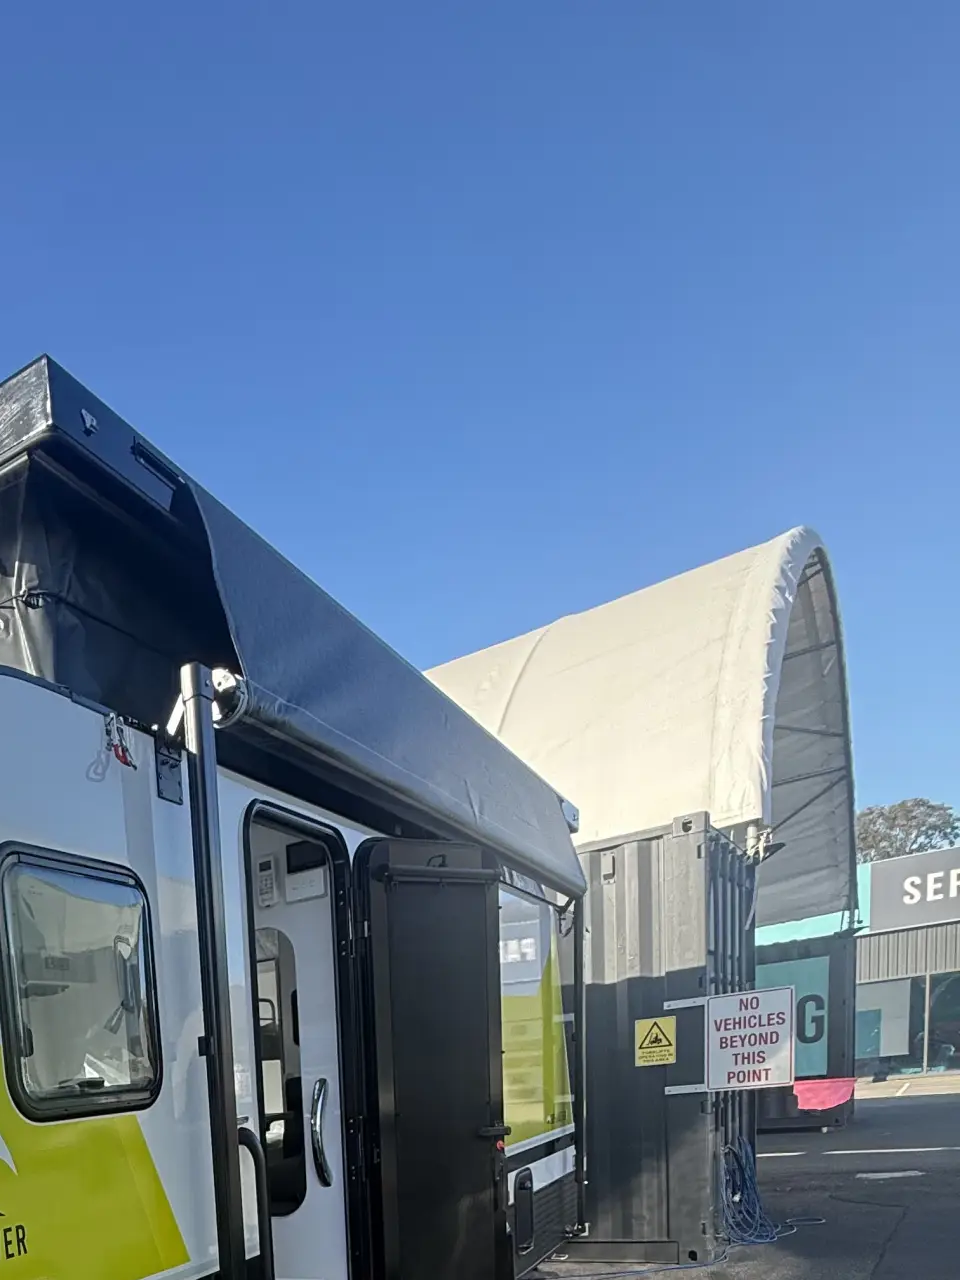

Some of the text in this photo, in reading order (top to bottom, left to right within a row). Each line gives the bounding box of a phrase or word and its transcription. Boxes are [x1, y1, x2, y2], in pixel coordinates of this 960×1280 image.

[739, 996, 759, 1011] NO
[714, 1011, 786, 1032] VEHICLES
[719, 1031, 780, 1049] BEYOND
[732, 1050, 766, 1066] THIS
[727, 1068, 771, 1085] POINT
